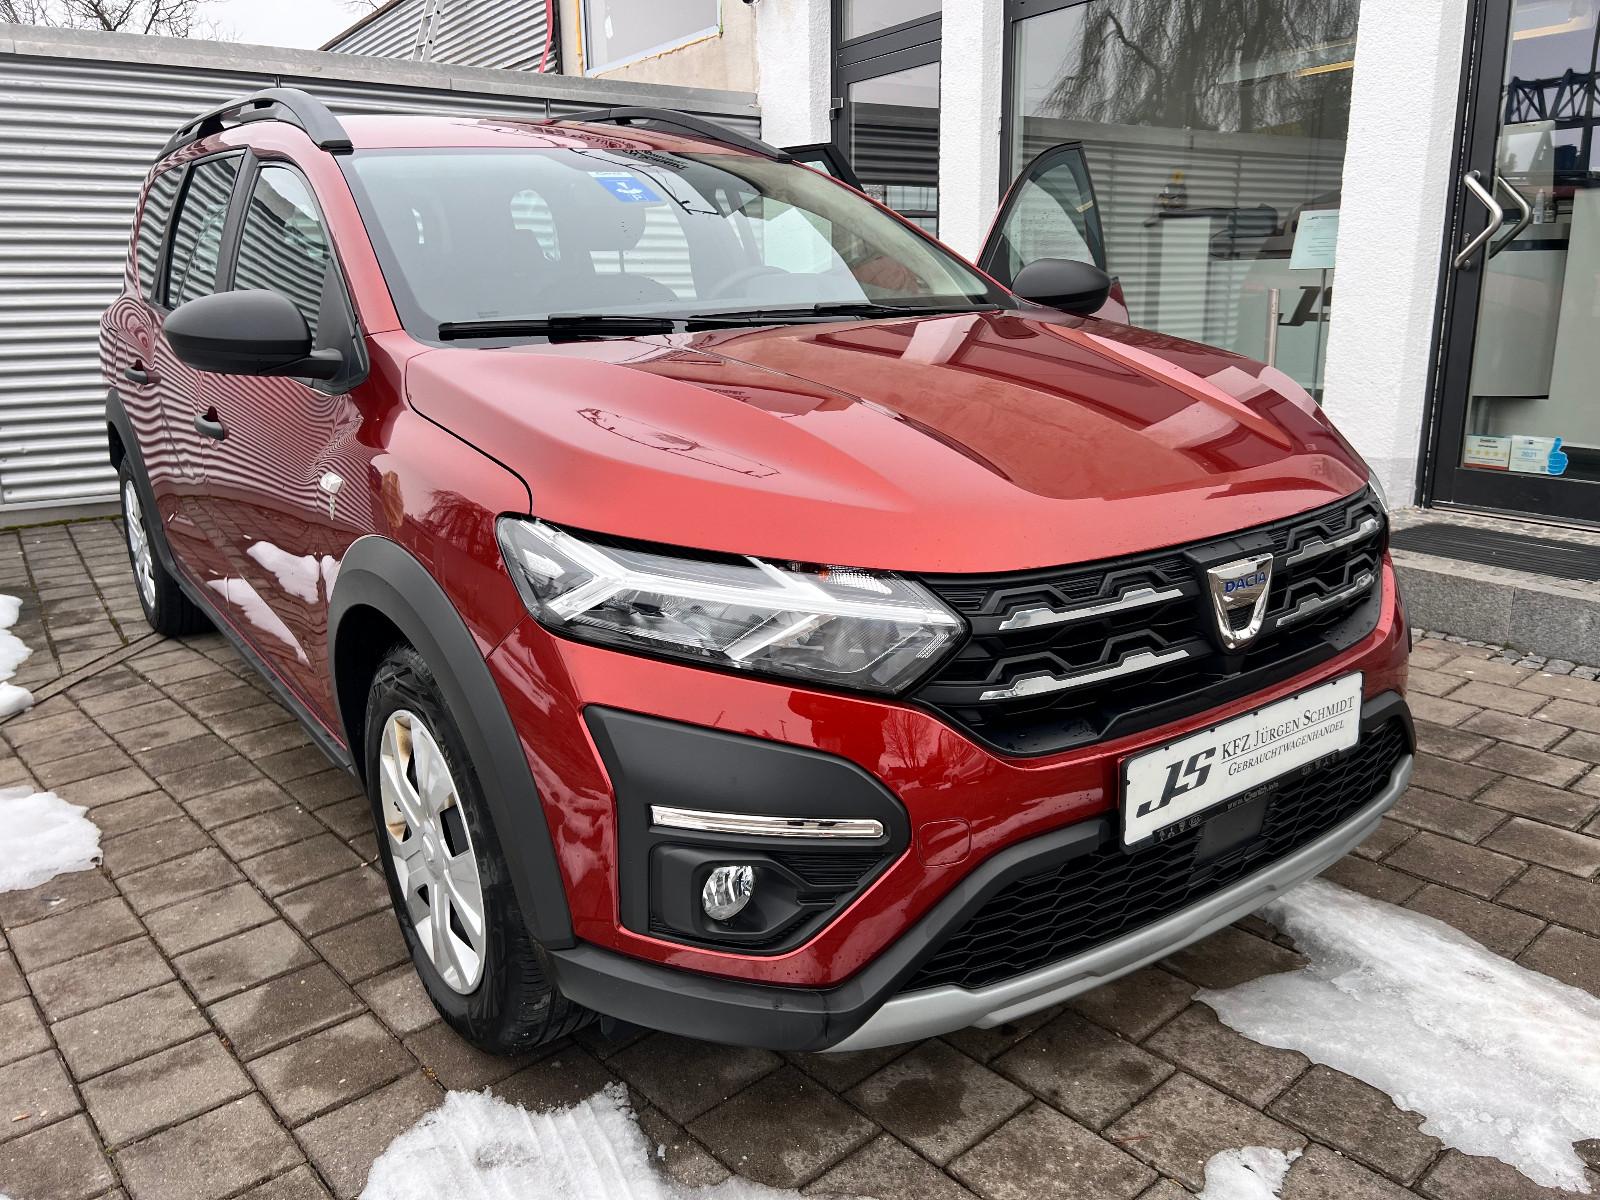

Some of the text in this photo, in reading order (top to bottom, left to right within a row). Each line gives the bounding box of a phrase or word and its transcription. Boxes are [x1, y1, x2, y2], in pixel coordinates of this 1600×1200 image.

[1225, 572, 1266, 592] DACIA
[1221, 696, 1355, 760] KFZ JÜRGEN SCHMIDT
[1228, 719, 1345, 776] GEBRAUCHTWAGENHANDEL
[1136, 747, 1216, 819] JS
